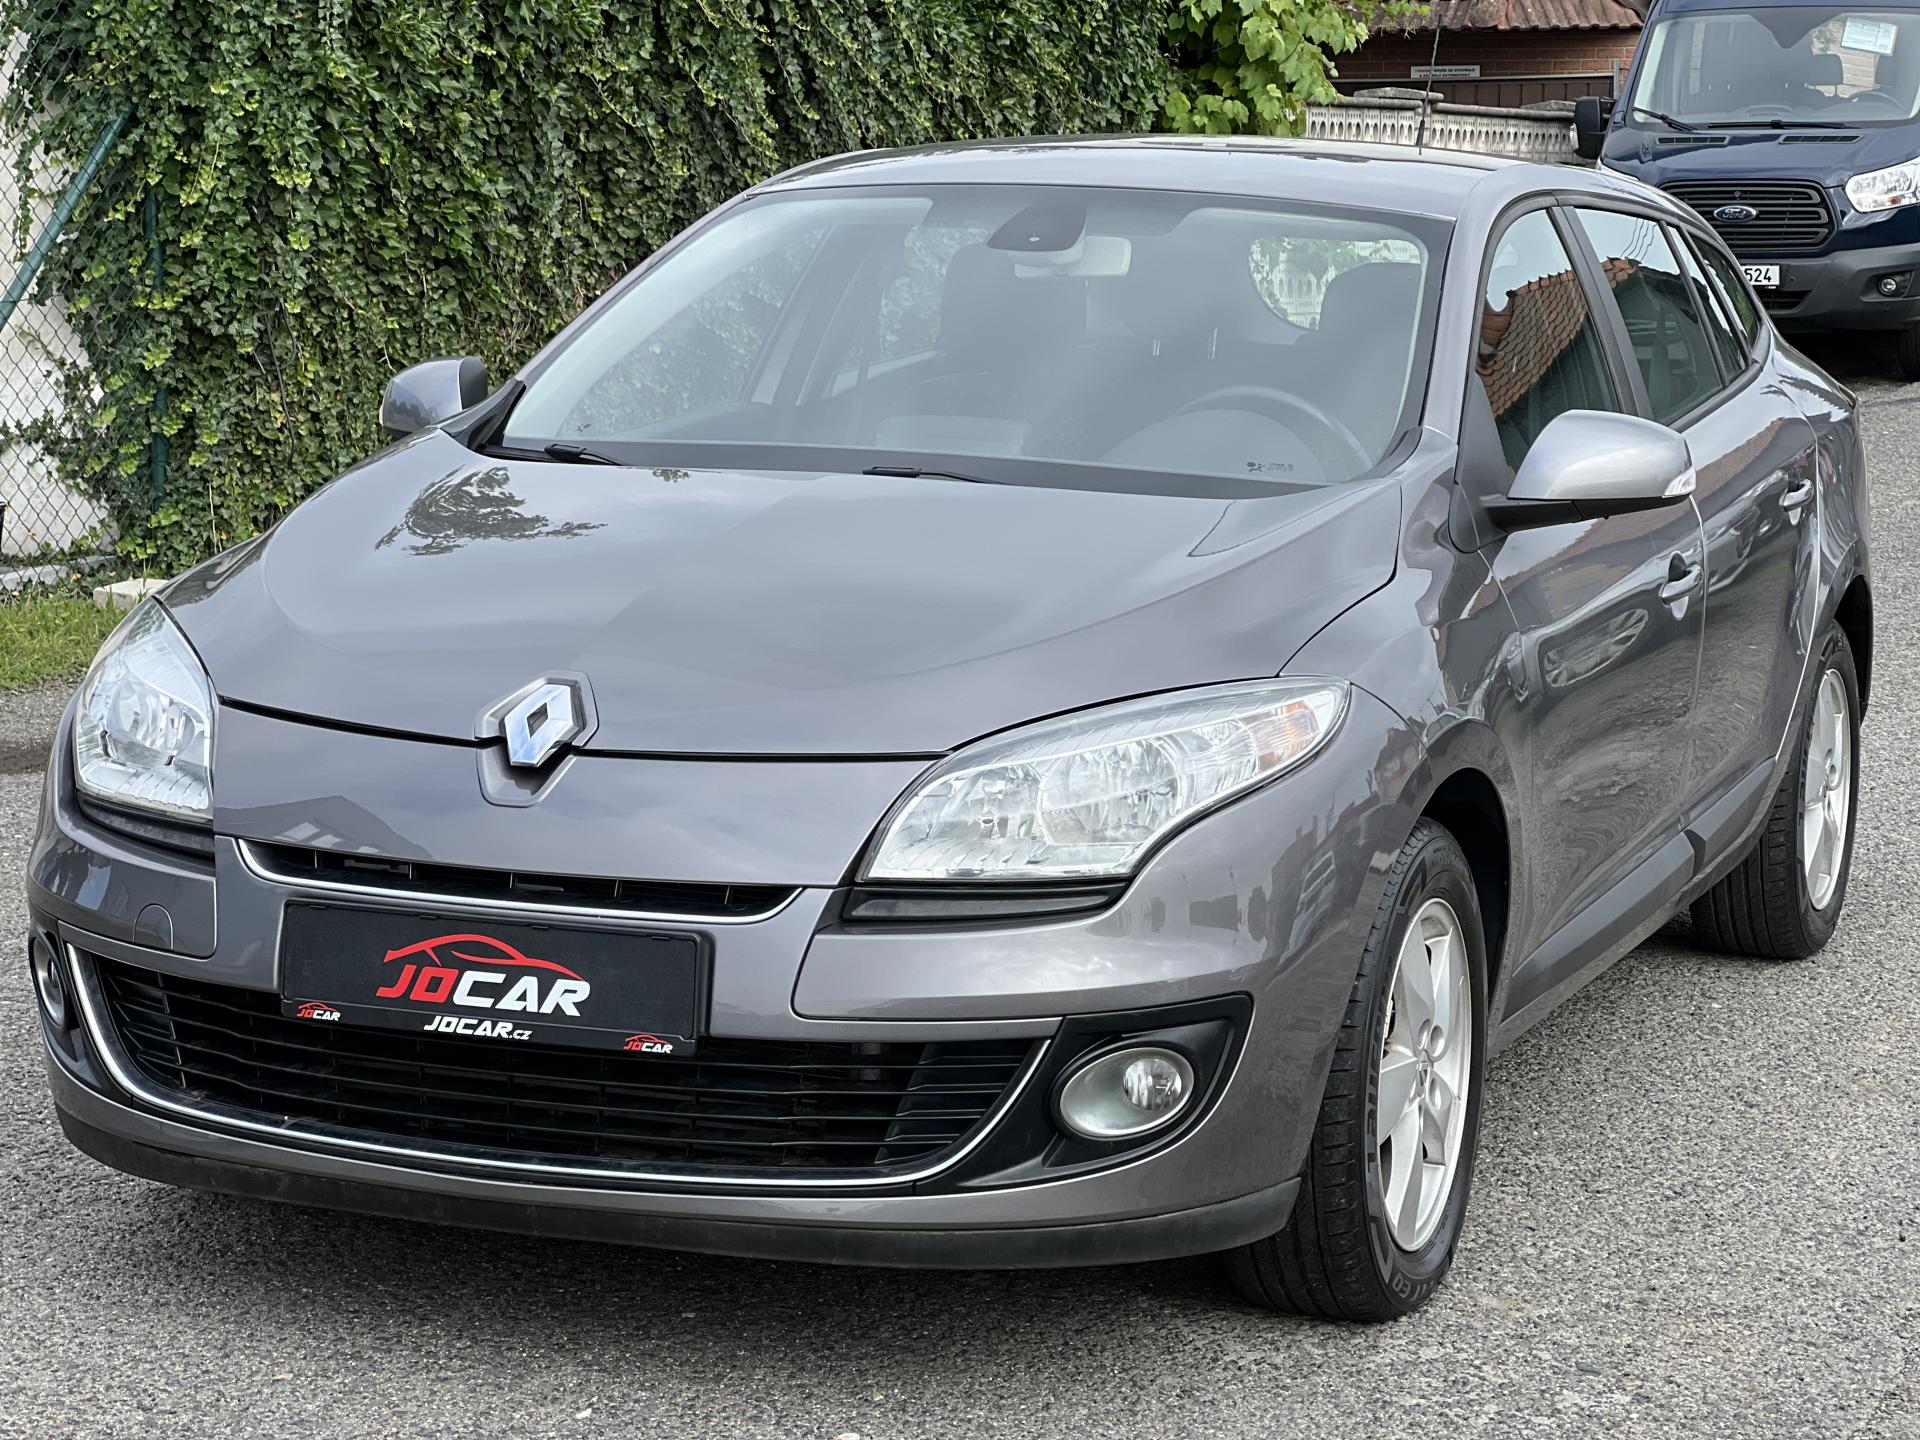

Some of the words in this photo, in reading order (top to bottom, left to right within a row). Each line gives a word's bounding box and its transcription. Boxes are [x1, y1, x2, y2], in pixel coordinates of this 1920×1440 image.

[1722, 208, 1747, 219] Ford
[1744, 268, 1771, 283] 524
[376, 964, 591, 1017] JOCAR
[296, 1008, 341, 1022] JOCAR
[623, 1040, 673, 1055] JOCAR
